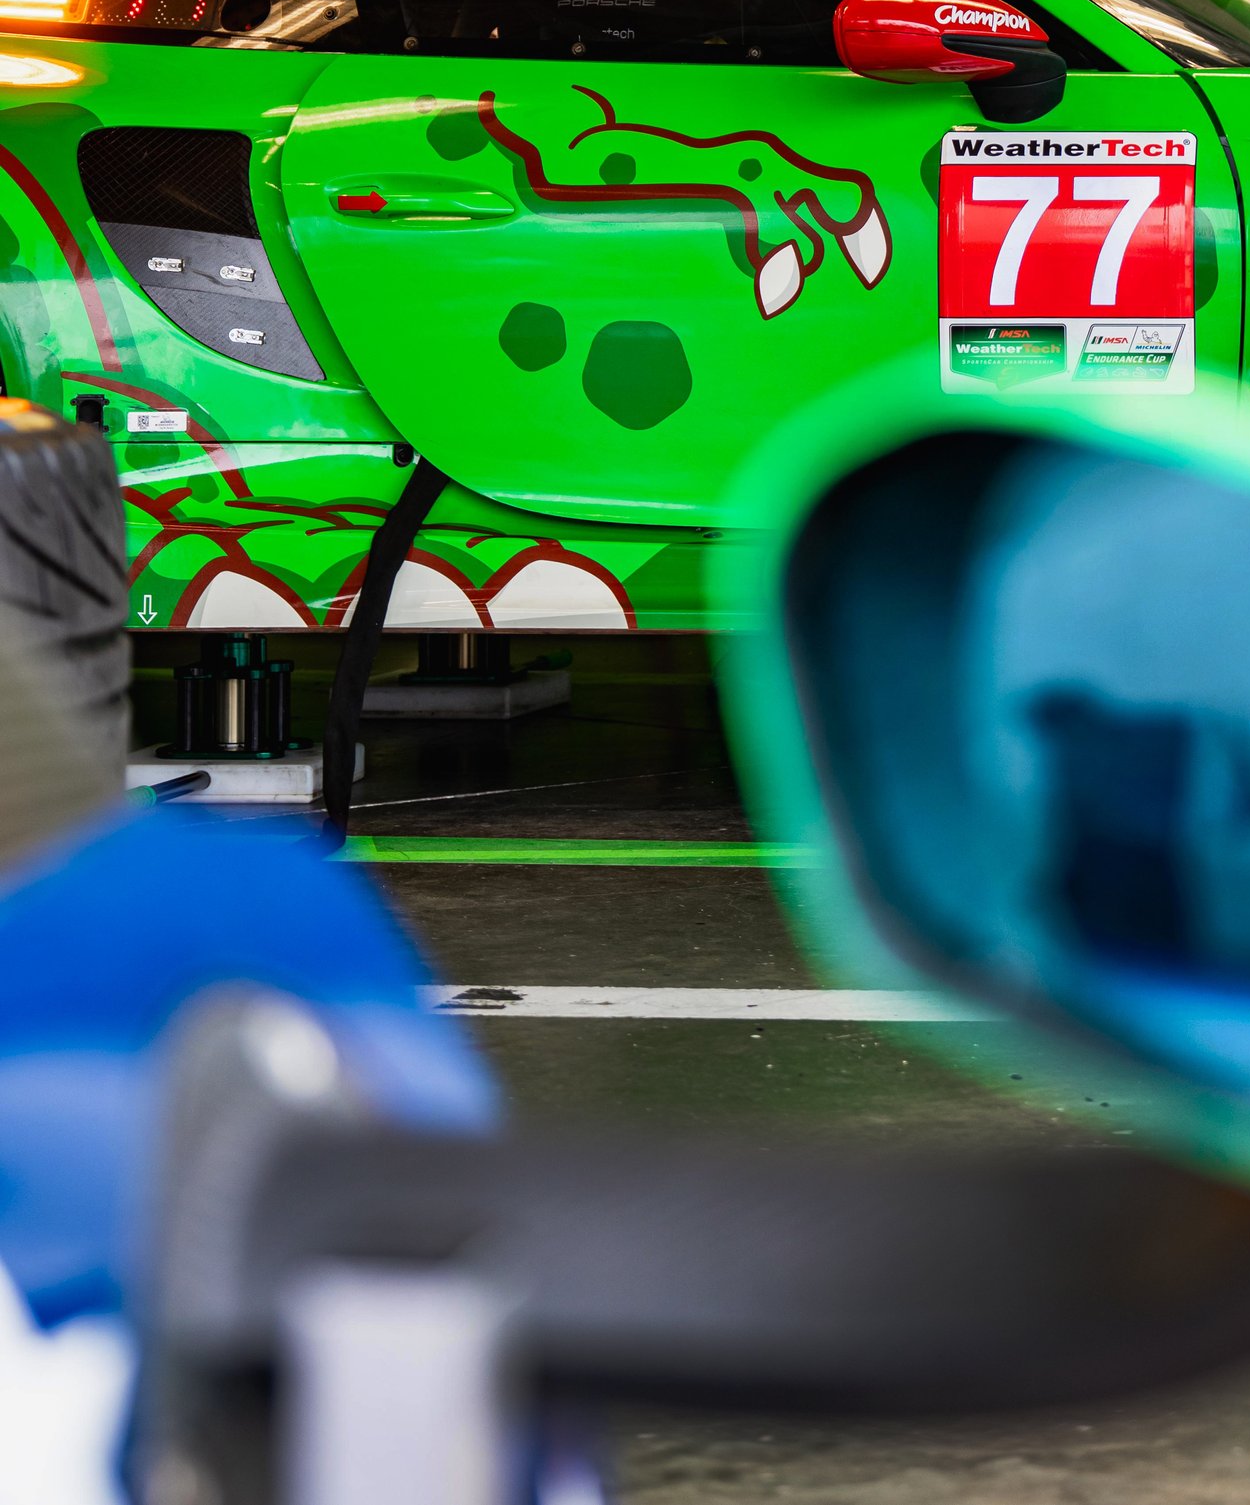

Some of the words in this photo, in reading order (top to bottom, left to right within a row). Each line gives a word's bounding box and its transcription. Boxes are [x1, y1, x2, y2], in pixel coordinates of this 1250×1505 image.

[934, 5, 1031, 32] Champion
[952, 139, 1186, 157] WeatherTech
[972, 176, 1160, 306] 77
[999, 329, 1031, 338] IMSA
[1102, 337, 1129, 345] IMSA
[956, 343, 1060, 354] WeatherTech
[1086, 353, 1144, 363] ENDURANCE
[1146, 354, 1166, 364] CUP
